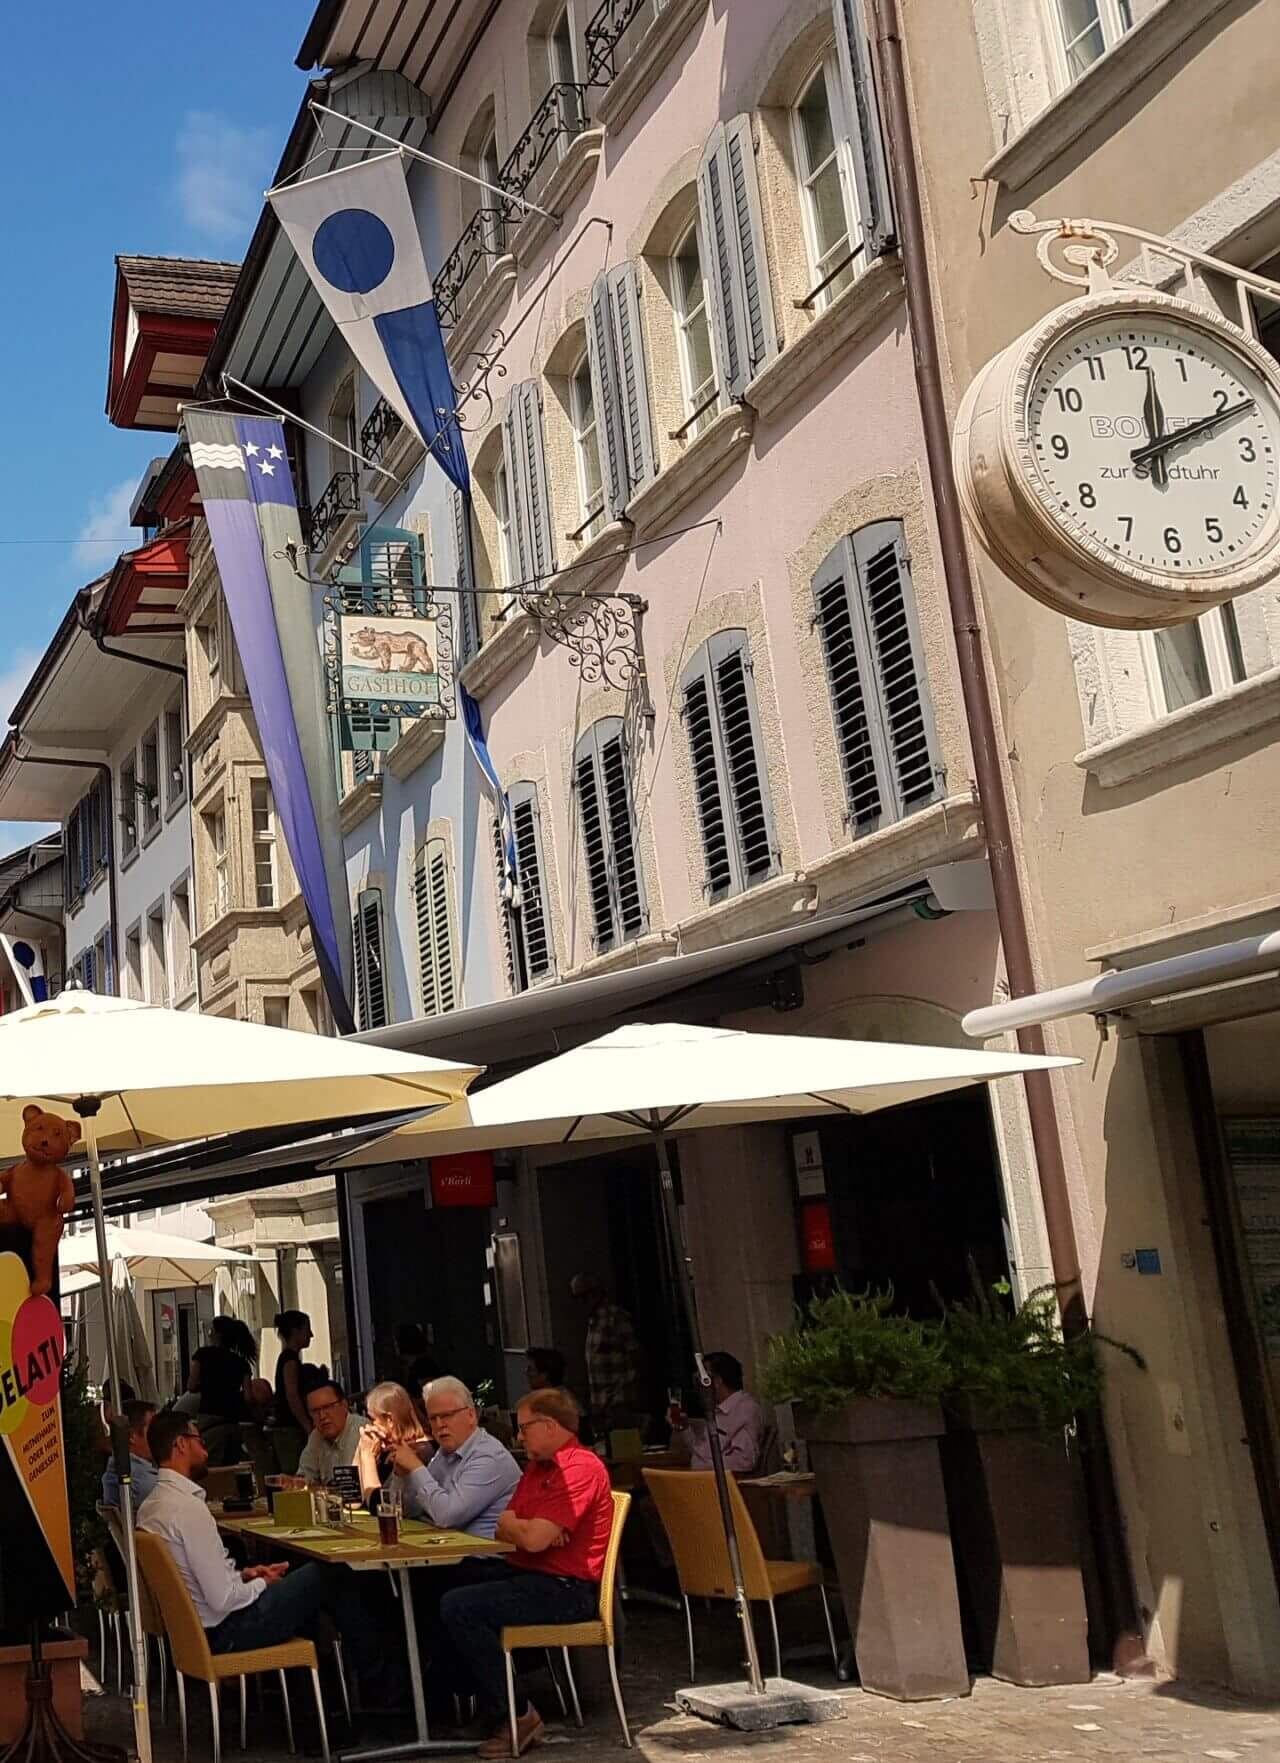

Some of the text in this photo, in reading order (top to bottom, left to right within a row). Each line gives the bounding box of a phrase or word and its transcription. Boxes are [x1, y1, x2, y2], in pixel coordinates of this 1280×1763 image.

[1084, 356, 1106, 380] 11
[1122, 346, 1149, 370] 12
[1175, 358, 1187, 382] 1
[1054, 387, 1083, 412] 10
[1051, 435, 1069, 460] 9
[1238, 437, 1256, 462] 3
[1134, 461, 1220, 480] Sdtuhr
[1078, 483, 1097, 508] 8
[1233, 485, 1249, 510] 4
[1117, 517, 1133, 542] 7
[1163, 527, 1181, 553] 6
[1205, 518, 1223, 543] 5
[348, 675, 433, 695] GASTHOF
